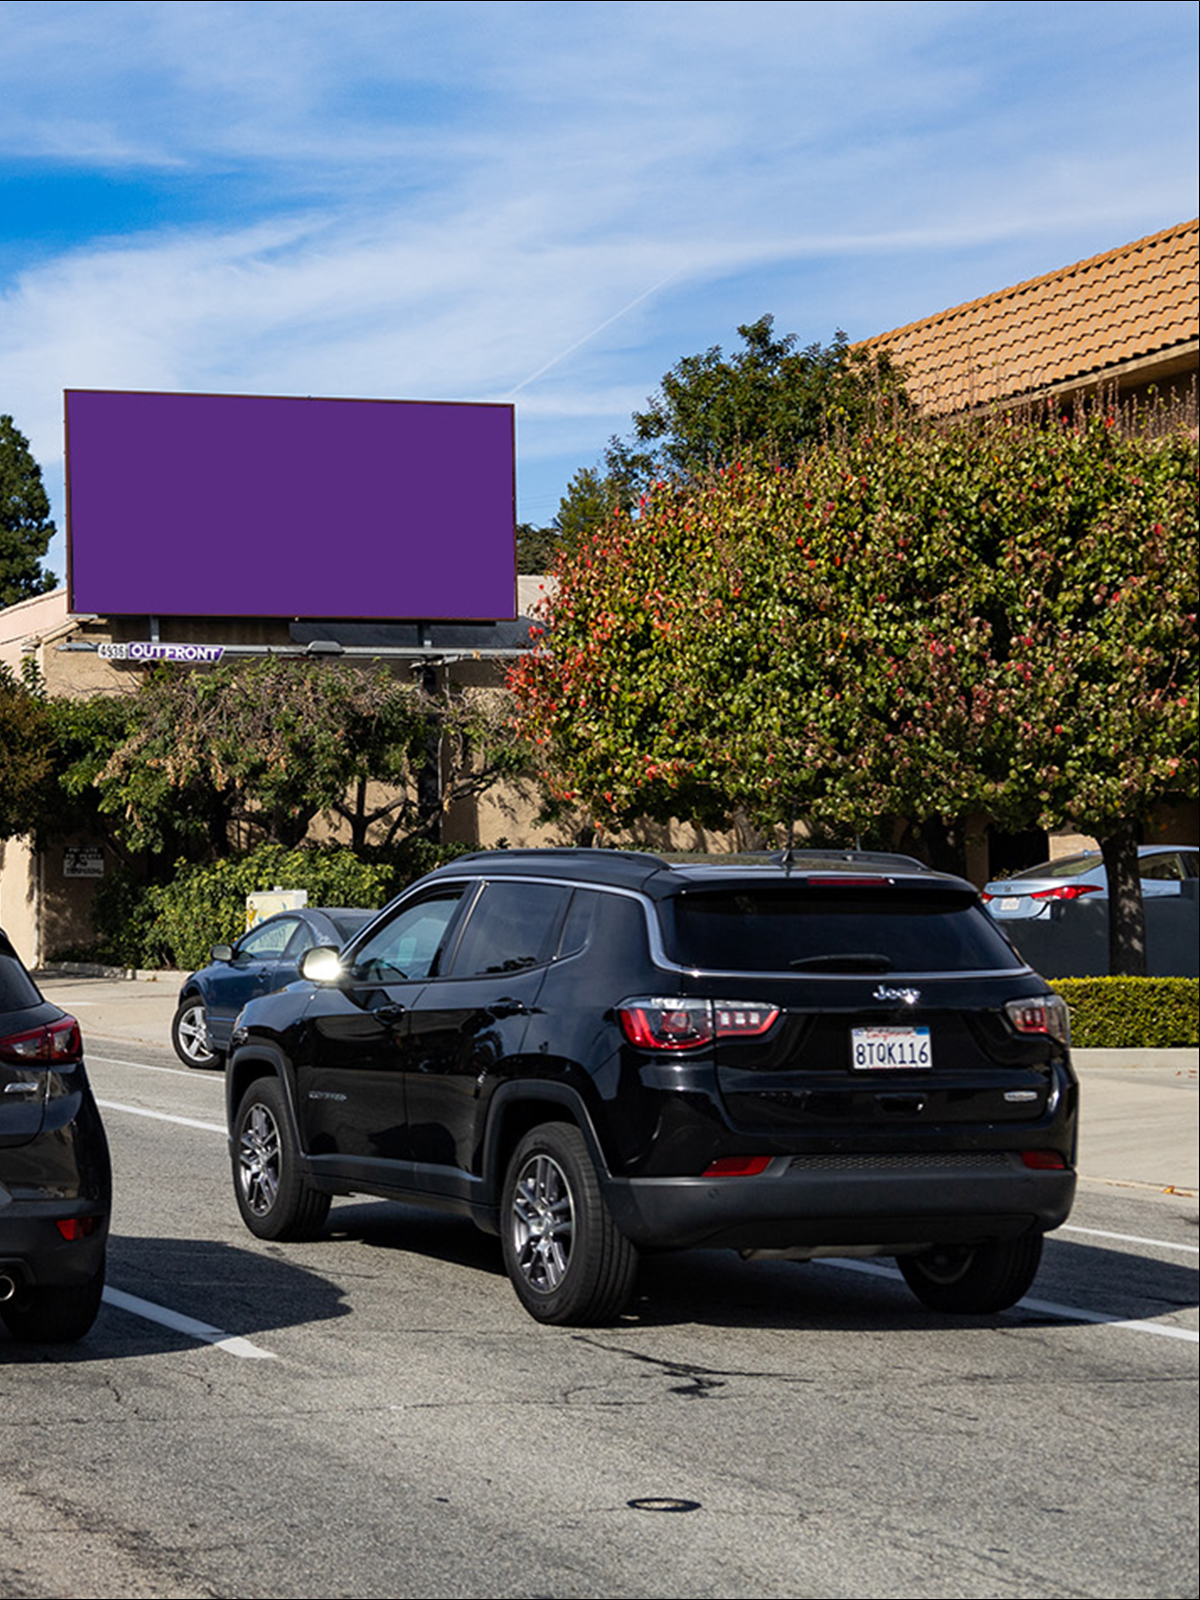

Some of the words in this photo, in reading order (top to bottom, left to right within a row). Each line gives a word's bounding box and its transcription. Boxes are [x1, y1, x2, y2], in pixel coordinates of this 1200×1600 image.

[131, 645, 219, 660] OUTFRONT
[873, 985, 921, 1002] Jeep
[856, 1042, 929, 1066] 8TQK116
